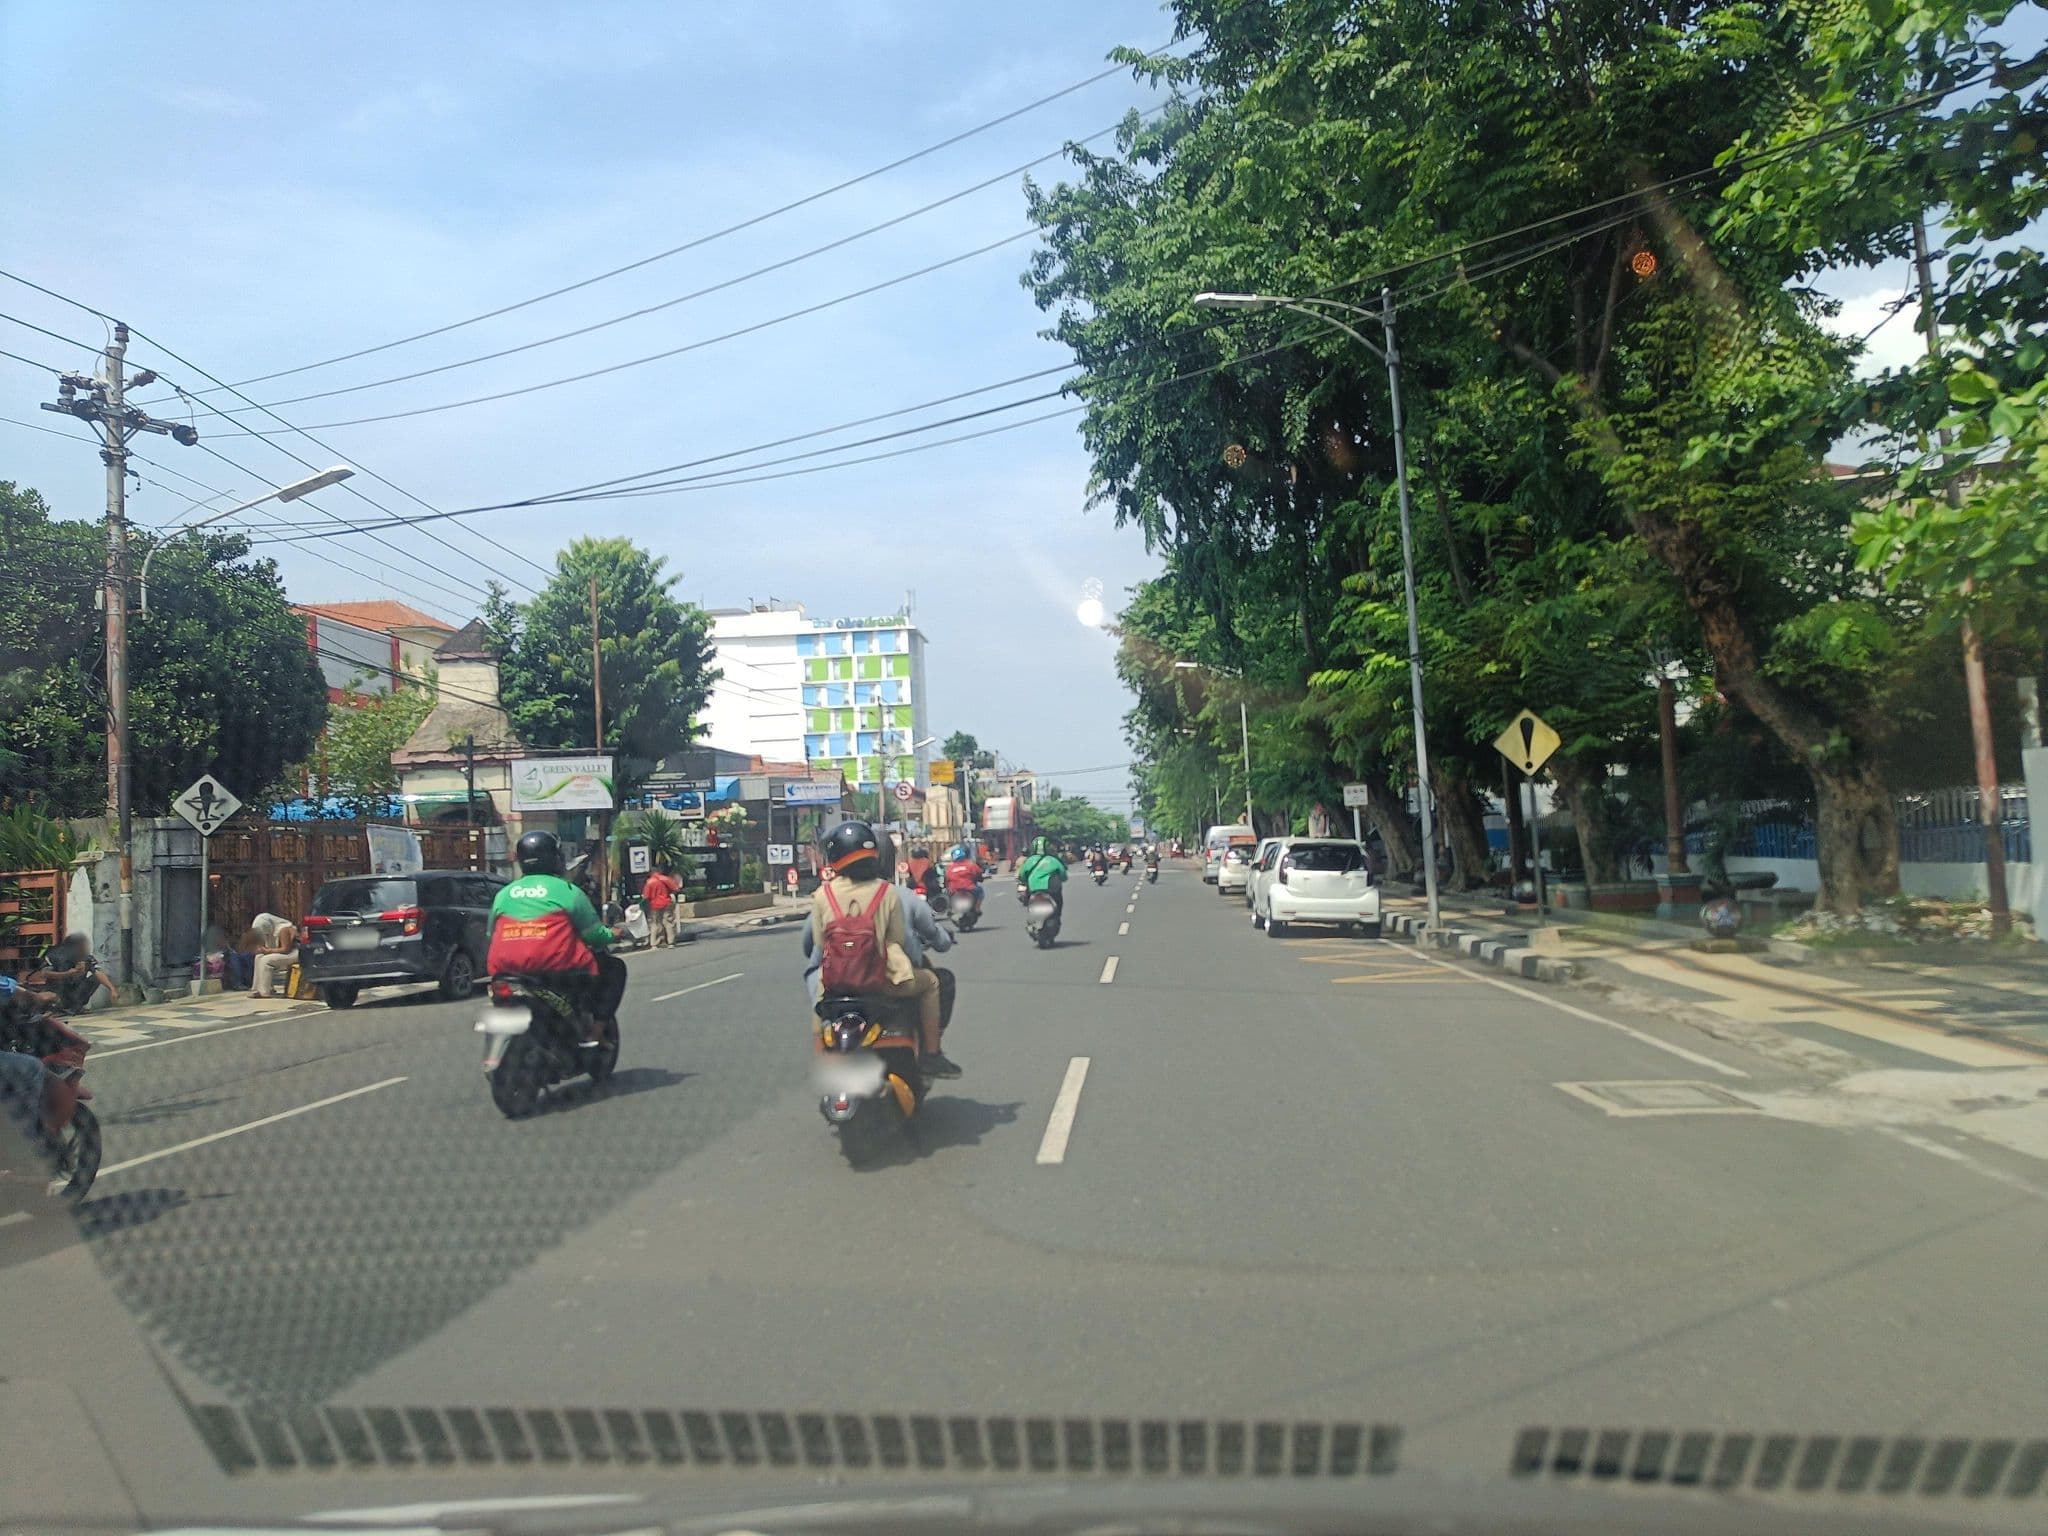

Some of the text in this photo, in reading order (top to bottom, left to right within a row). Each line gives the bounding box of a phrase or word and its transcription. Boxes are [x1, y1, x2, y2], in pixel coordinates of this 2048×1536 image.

[543, 764, 608, 774] GREEN VALLEY
[510, 884, 547, 898] Grab
